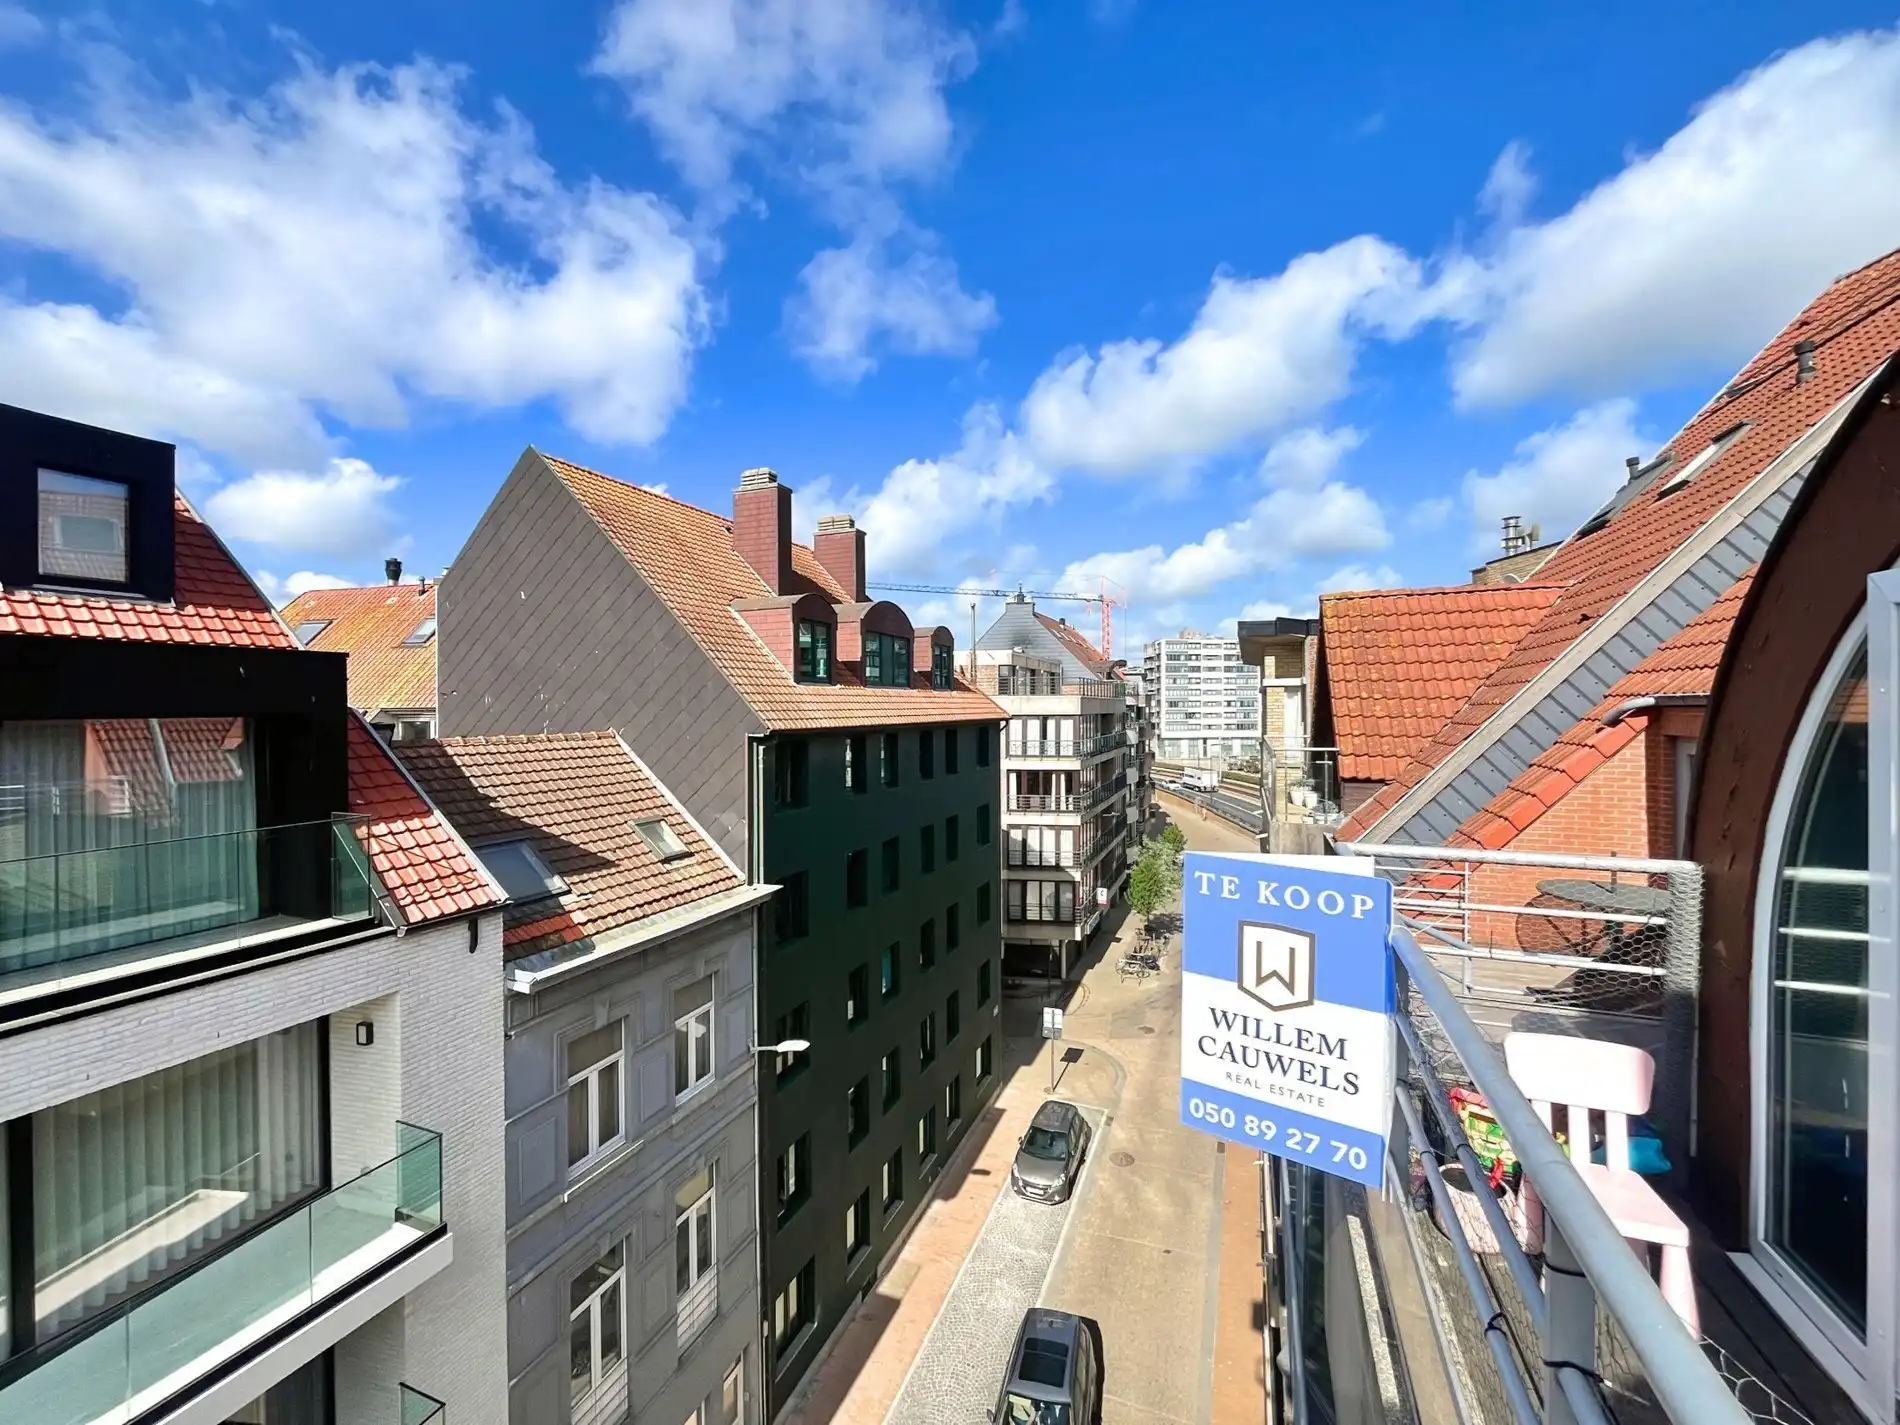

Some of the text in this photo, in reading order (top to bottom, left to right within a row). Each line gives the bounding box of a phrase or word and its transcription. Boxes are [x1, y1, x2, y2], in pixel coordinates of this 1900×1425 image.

[1194, 871, 1374, 919] TE KOOP
[1208, 1006, 1348, 1061] WILLEM
[1198, 1035, 1360, 1096] CAUWELS
[1225, 1071, 1325, 1108] REAL ESTATE
[1189, 1097, 1367, 1170] 050 89 27 70
